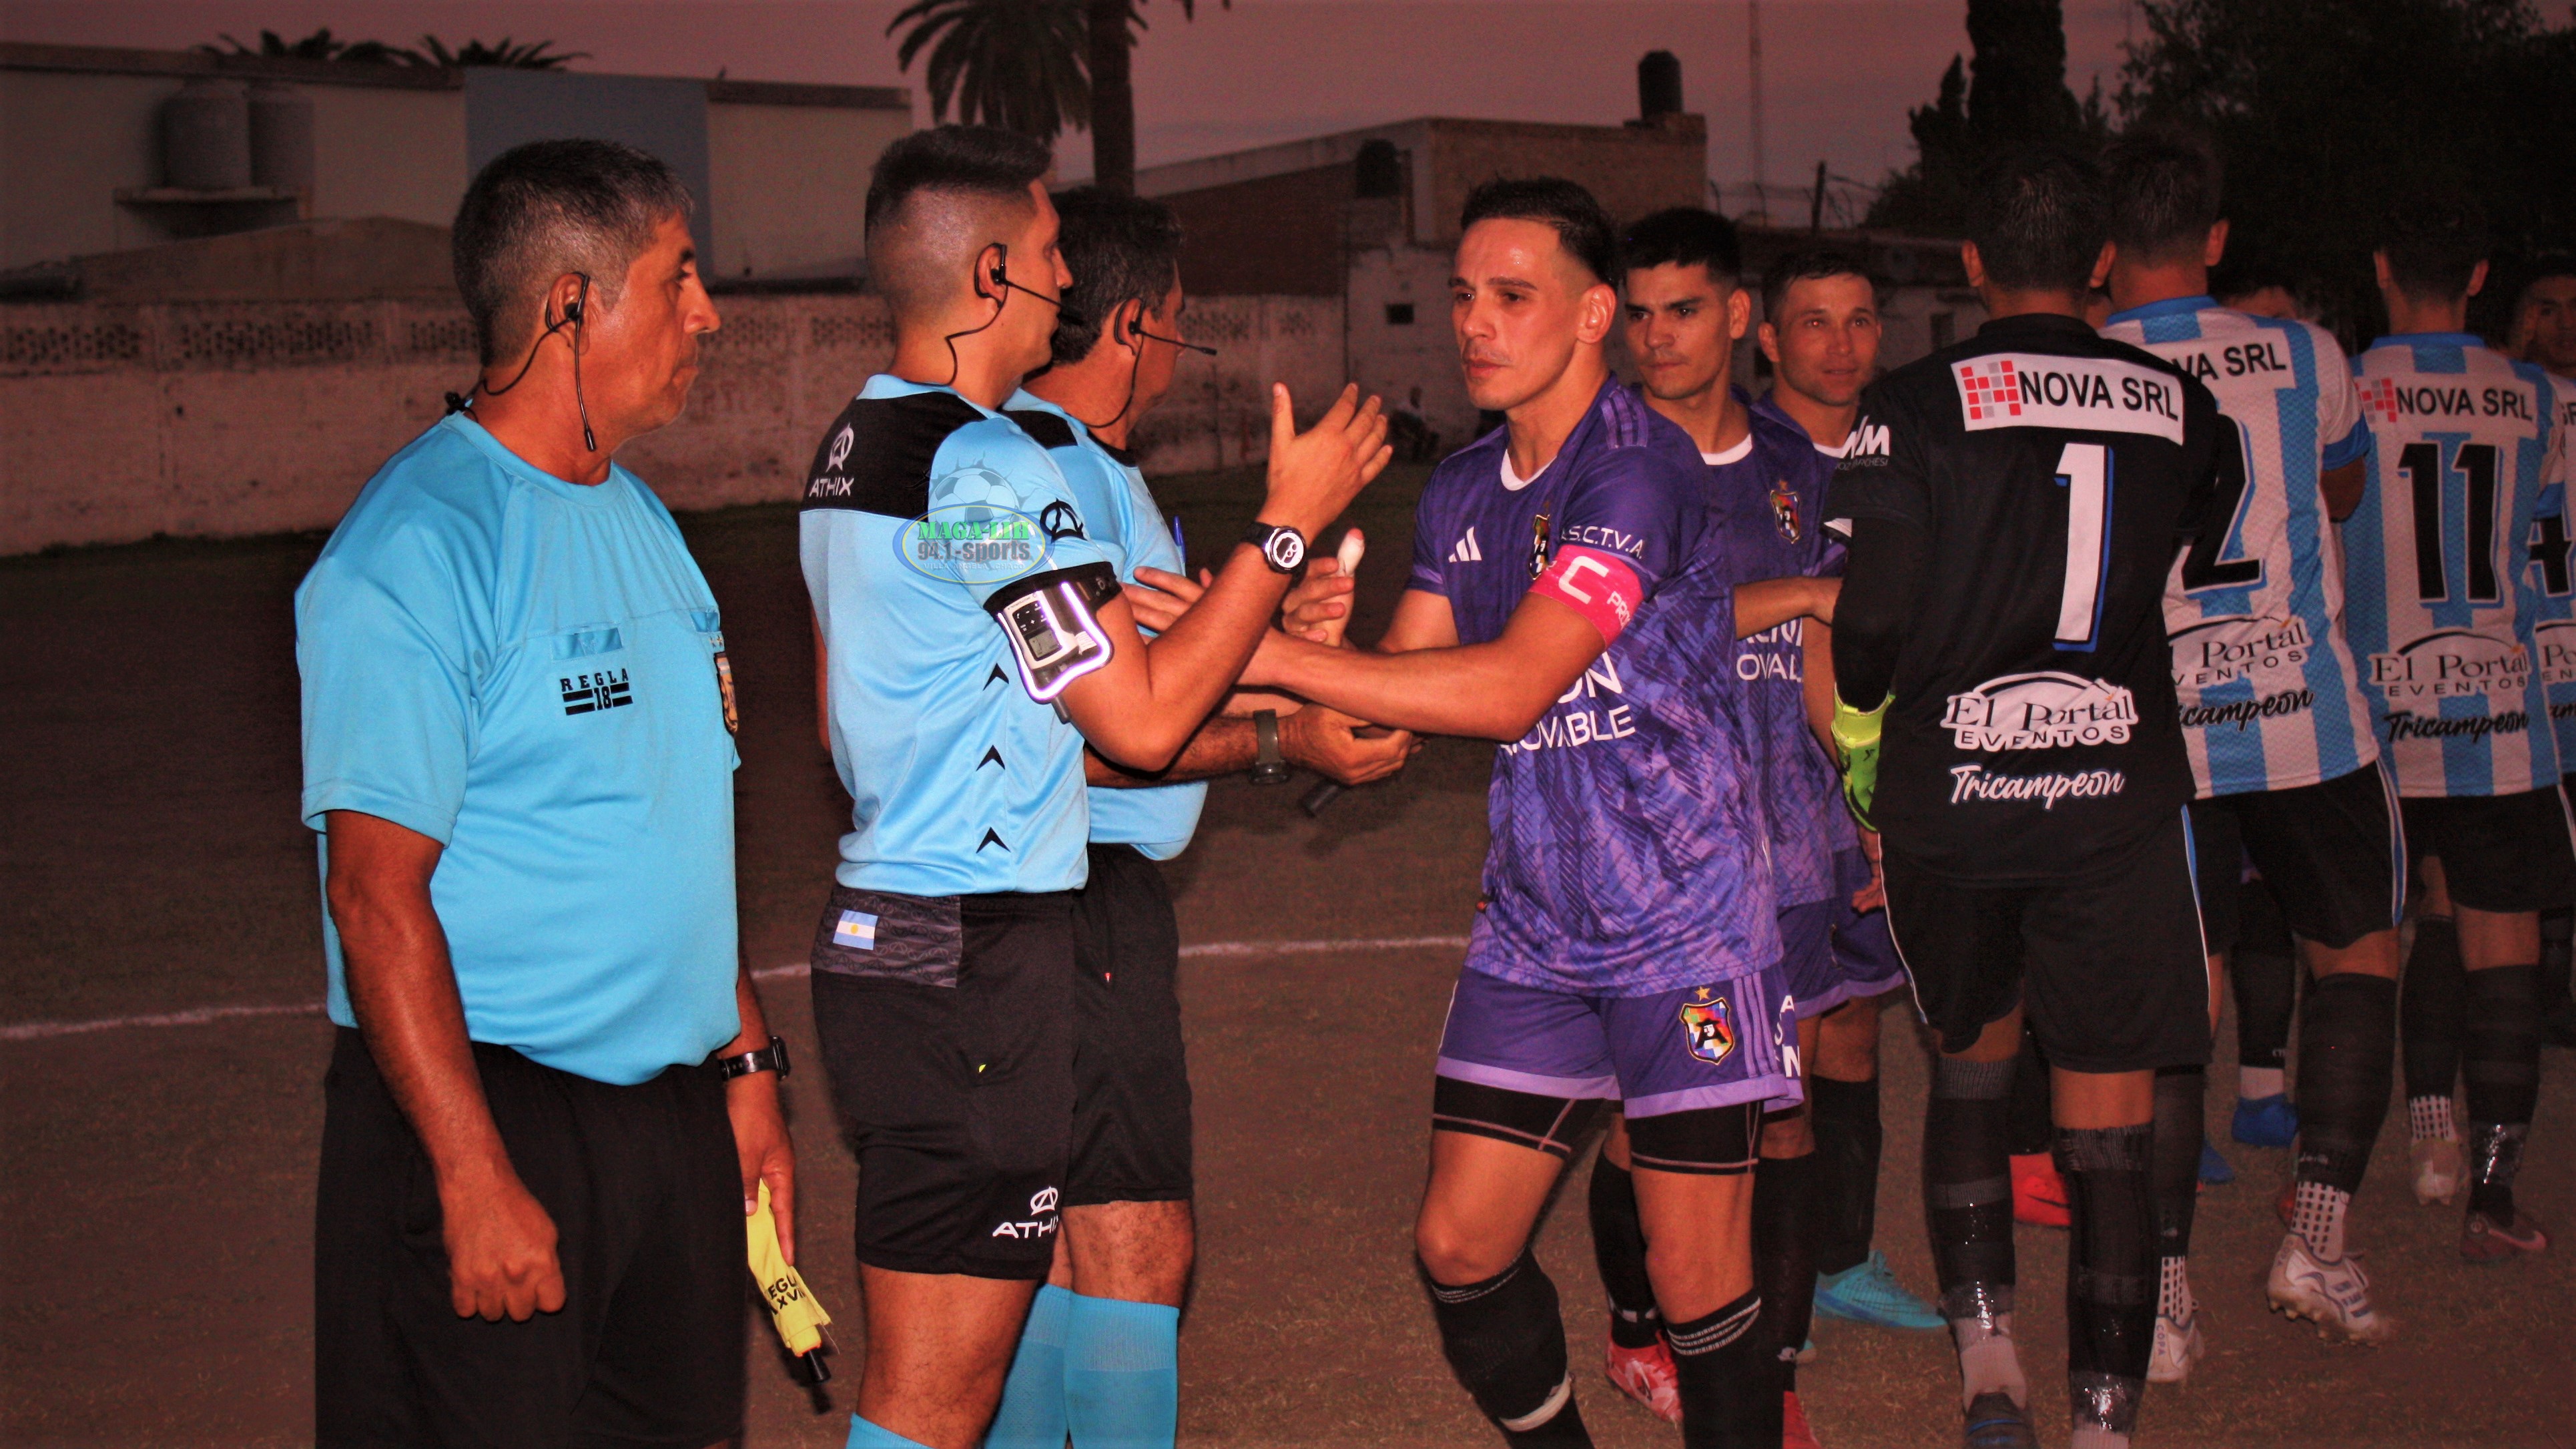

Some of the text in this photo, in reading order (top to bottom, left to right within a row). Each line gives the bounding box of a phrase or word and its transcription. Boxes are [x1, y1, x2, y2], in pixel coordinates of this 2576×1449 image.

[2224, 343, 2287, 376] SRL
[2018, 371, 2179, 422] NOVA SRL
[2396, 387, 2533, 422] NOVA SRL
[809, 477, 854, 497] ATHIX
[2181, 412, 2264, 591] 2
[2398, 443, 2500, 602] 11
[2055, 443, 2110, 647] 1
[1558, 556, 1609, 605] C
[2203, 622, 2304, 667] Portal
[560, 668, 629, 692] REGLA
[2376, 652, 2528, 681] El Portal
[593, 686, 613, 711] 18
[2389, 676, 2525, 696] EVENTOS
[1949, 695, 2132, 731] El Portal
[2382, 710, 2529, 744] Tricampeon
[1961, 726, 2125, 746] EVENTOS
[1949, 765, 2125, 810] Tricampeon
[2156, 1325, 2166, 1356] COPA
